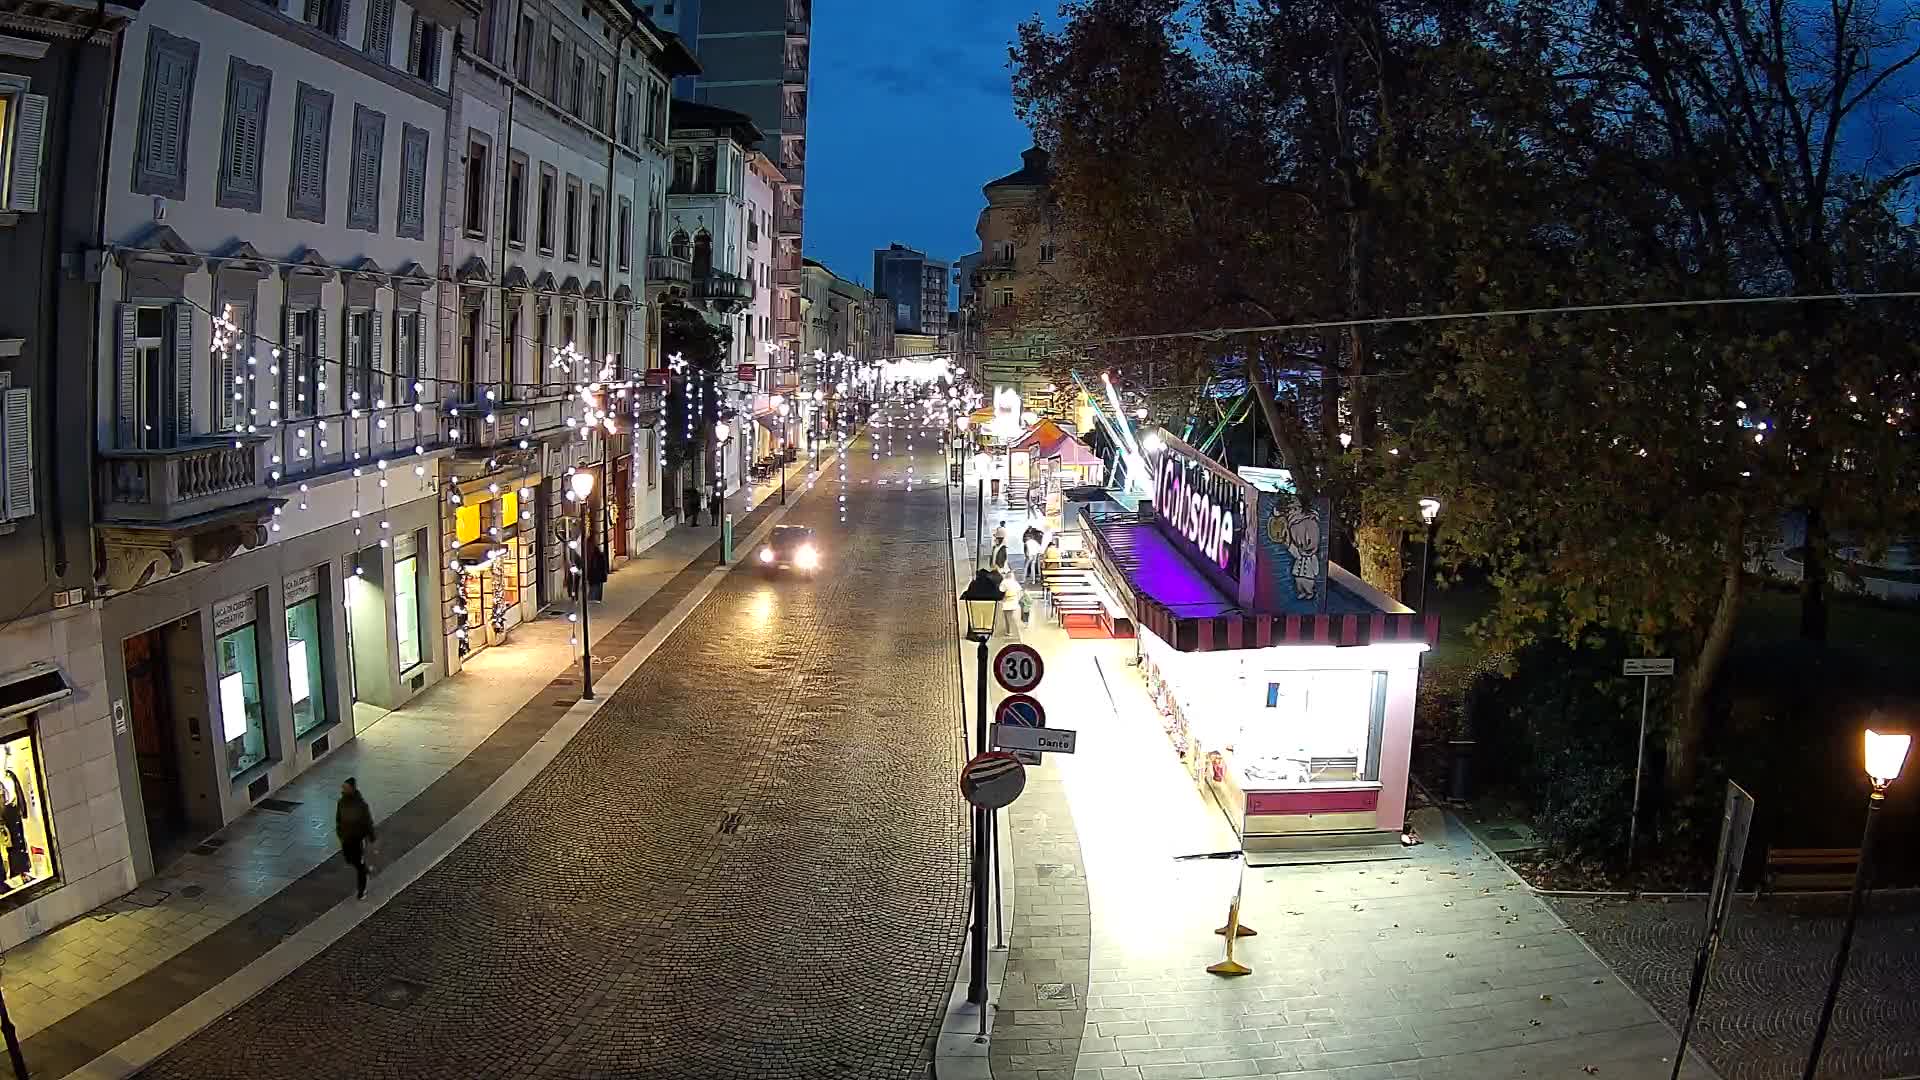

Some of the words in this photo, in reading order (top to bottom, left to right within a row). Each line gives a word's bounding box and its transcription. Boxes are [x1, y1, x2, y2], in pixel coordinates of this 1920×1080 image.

[1163, 455, 1233, 569] Golosone
[1006, 658, 1032, 679] 30
[1039, 738, 1069, 748] Dante
